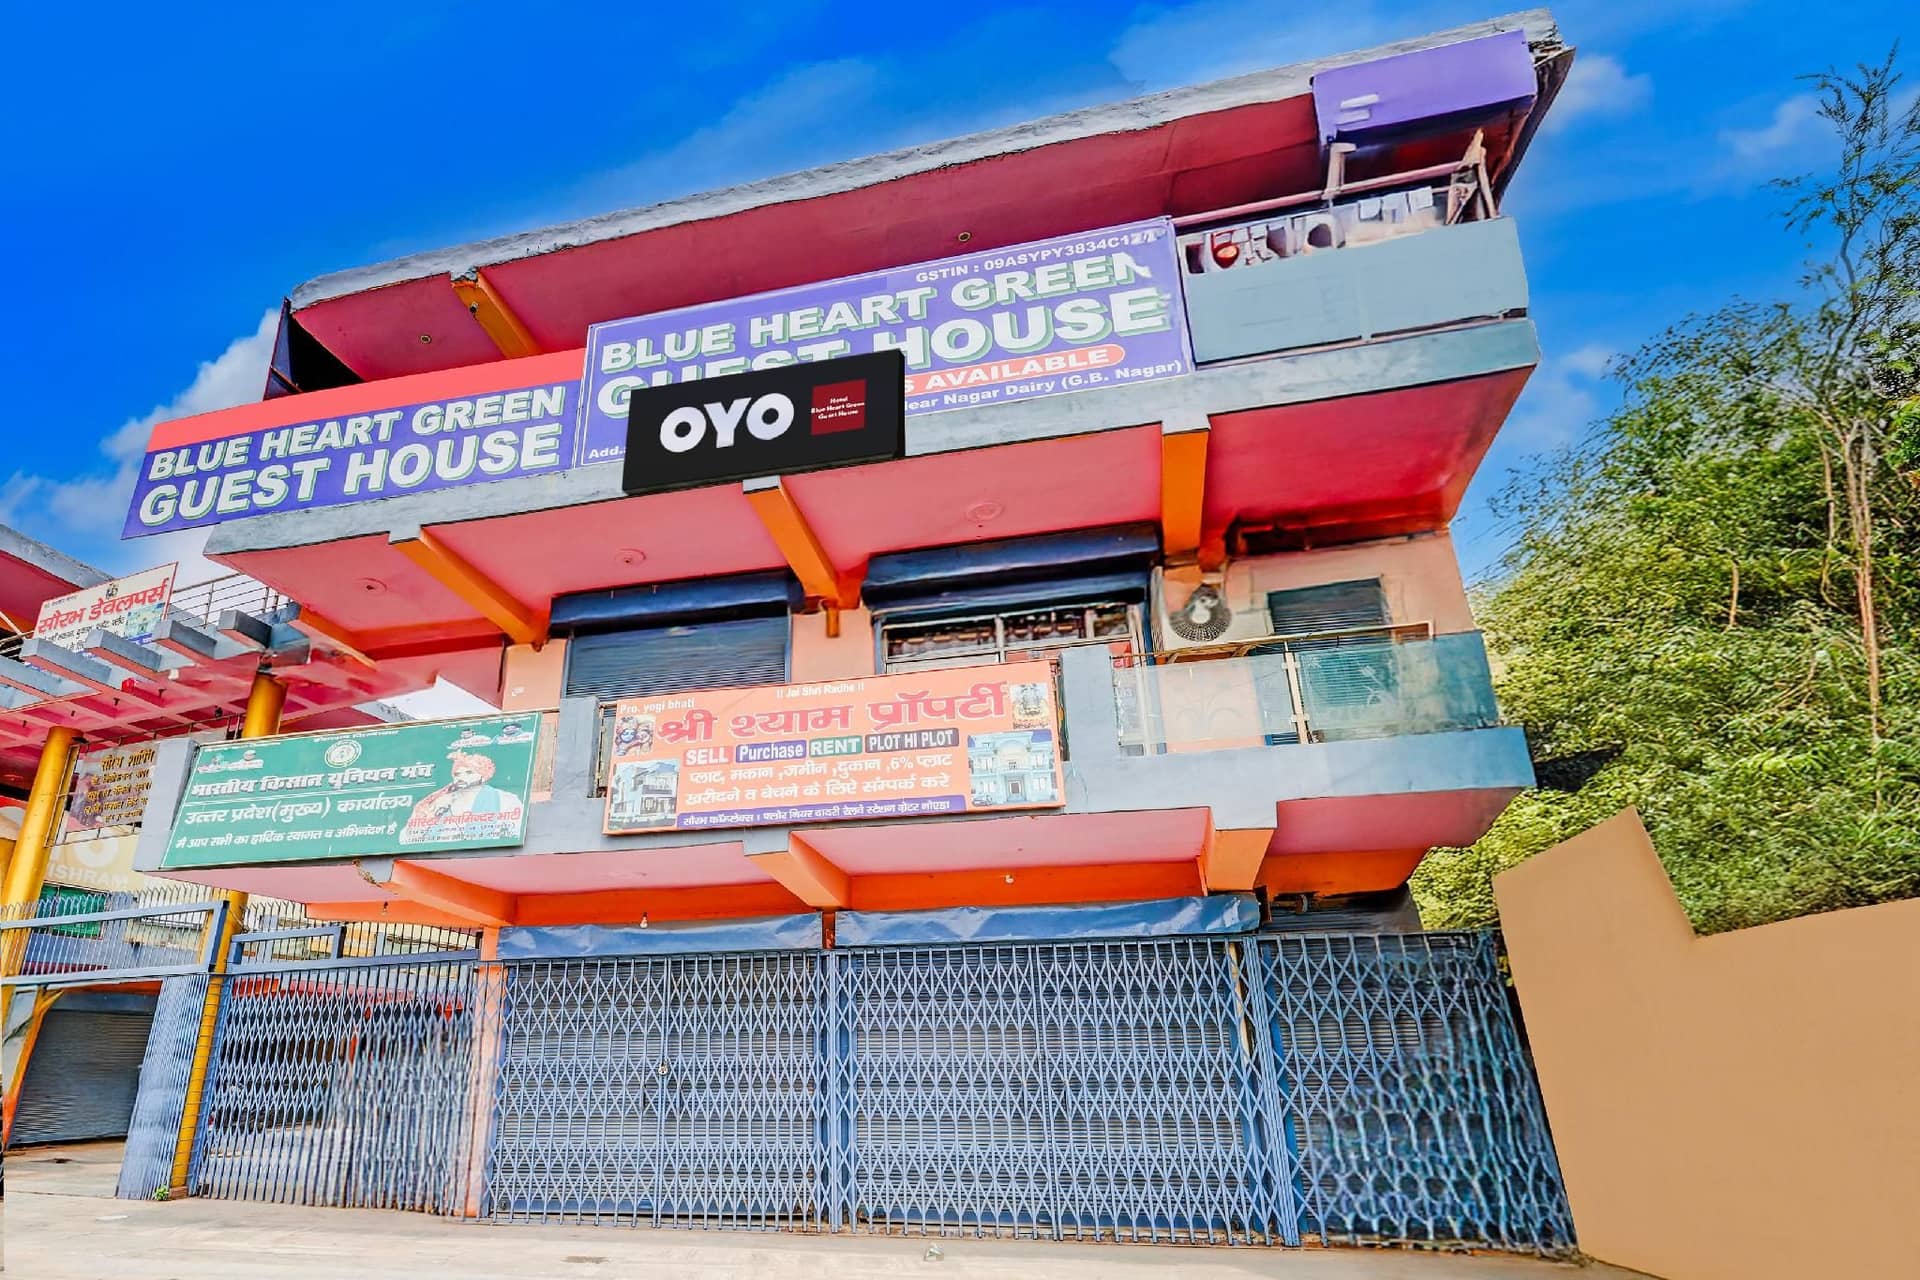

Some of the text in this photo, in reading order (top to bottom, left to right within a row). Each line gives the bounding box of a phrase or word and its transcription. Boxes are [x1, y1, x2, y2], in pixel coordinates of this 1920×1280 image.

[916, 264, 969, 283] GSTIN
[600, 322, 736, 375] BLUE
[749, 287, 937, 348] HEART
[873, 287, 1170, 369] HOUSE
[905, 398, 939, 411] ear
[943, 388, 1000, 405] Nagar
[1006, 379, 1055, 400] Dairy
[1116, 360, 1182, 380] Nagar)
[926, 348, 1110, 390] AVAILABLE
[148, 385, 566, 481] BLUE HEART GREEN
[659, 392, 795, 453] OYO
[138, 422, 562, 527] GUEST HOUSE
[657, 708, 718, 743] श्री
[729, 705, 854, 738] श्याम
[869, 731, 953, 751] PLOT HI PLOT
[685, 748, 728, 766] SELL
[739, 743, 804, 761] Purchase
[810, 738, 862, 756] RENT
[191, 779, 258, 796] भारतीय
[260, 775, 324, 791] किसान
[328, 767, 397, 789] यूनियन
[185, 809, 229, 824] उत्तर
[337, 792, 413, 813] कार्यालय
[187, 838, 209, 848] आप
[210, 833, 233, 847] सभी
[234, 835, 249, 845] का
[251, 830, 286, 845] हार्दिक
[287, 830, 323, 841] स्वागत
